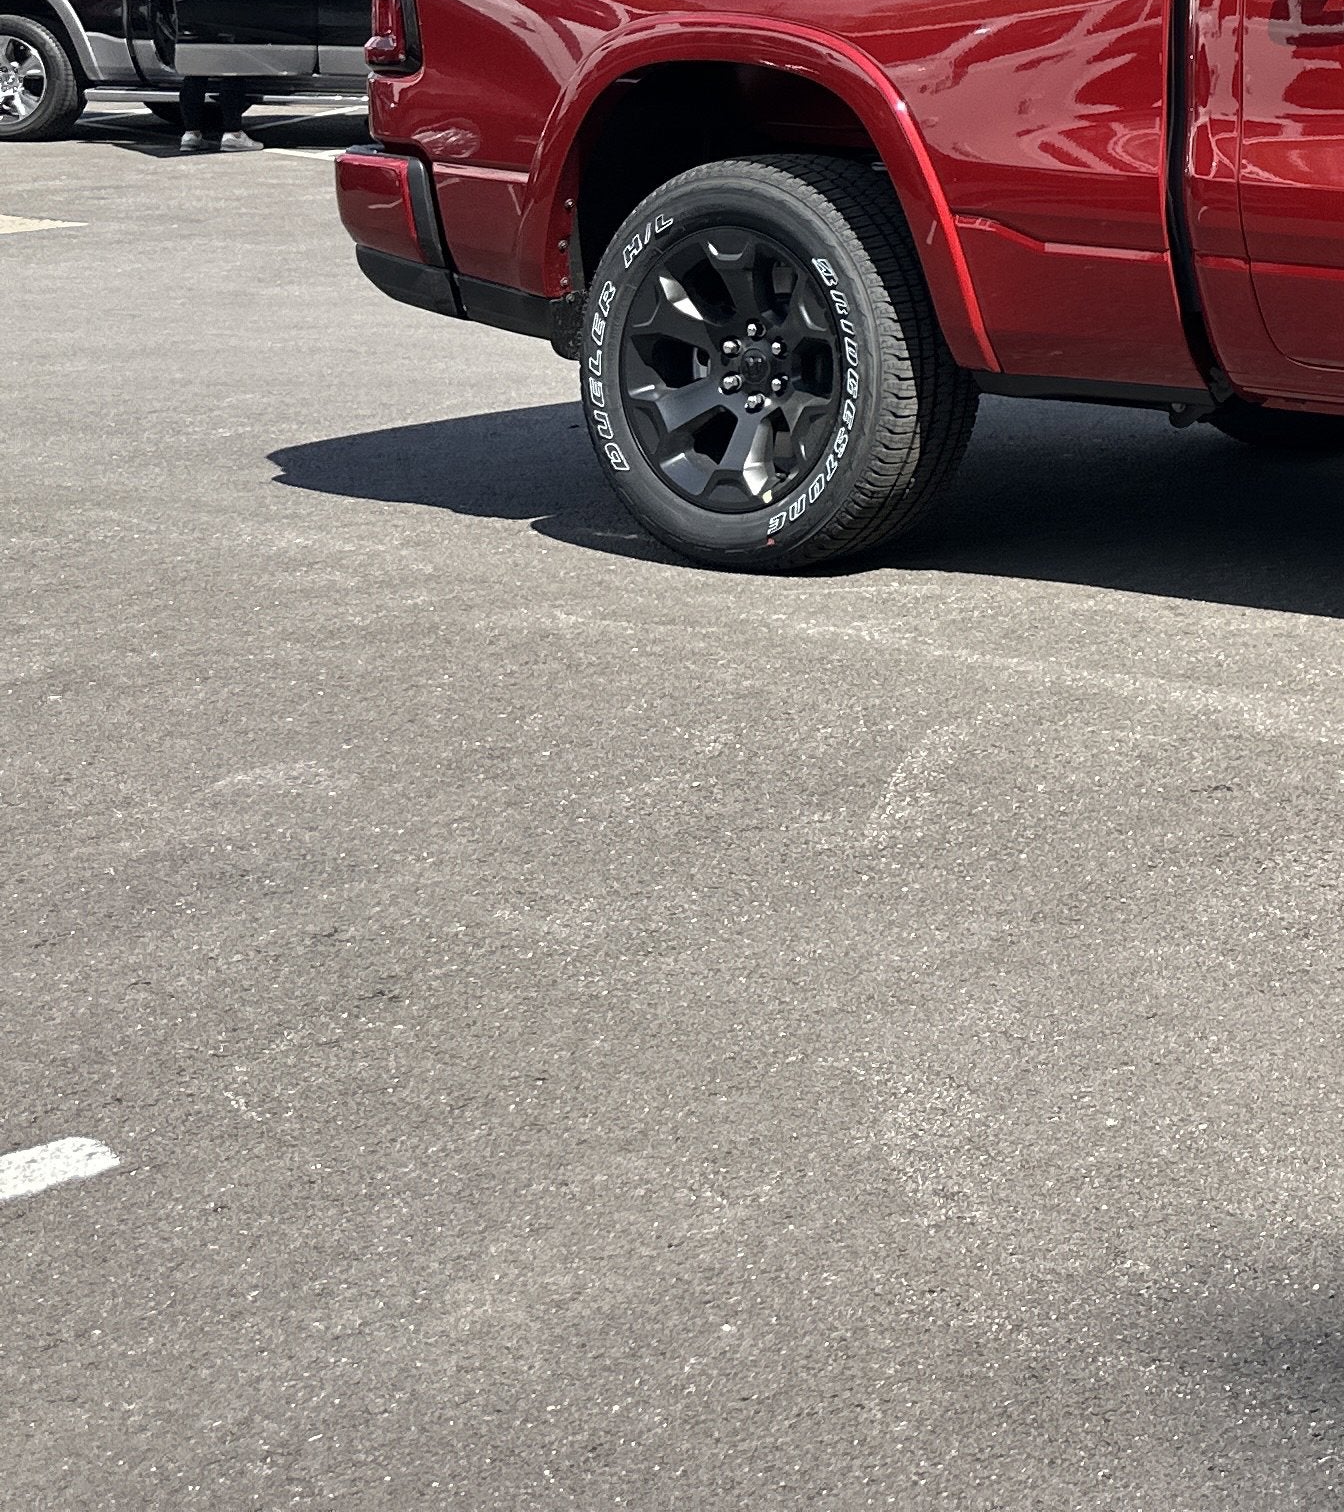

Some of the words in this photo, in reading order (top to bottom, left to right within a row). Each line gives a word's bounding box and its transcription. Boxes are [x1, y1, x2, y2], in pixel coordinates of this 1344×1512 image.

[589, 280, 630, 471] DUELER
[622, 213, 674, 269] H/L
[766, 257, 860, 535] BRIDGESTONE
